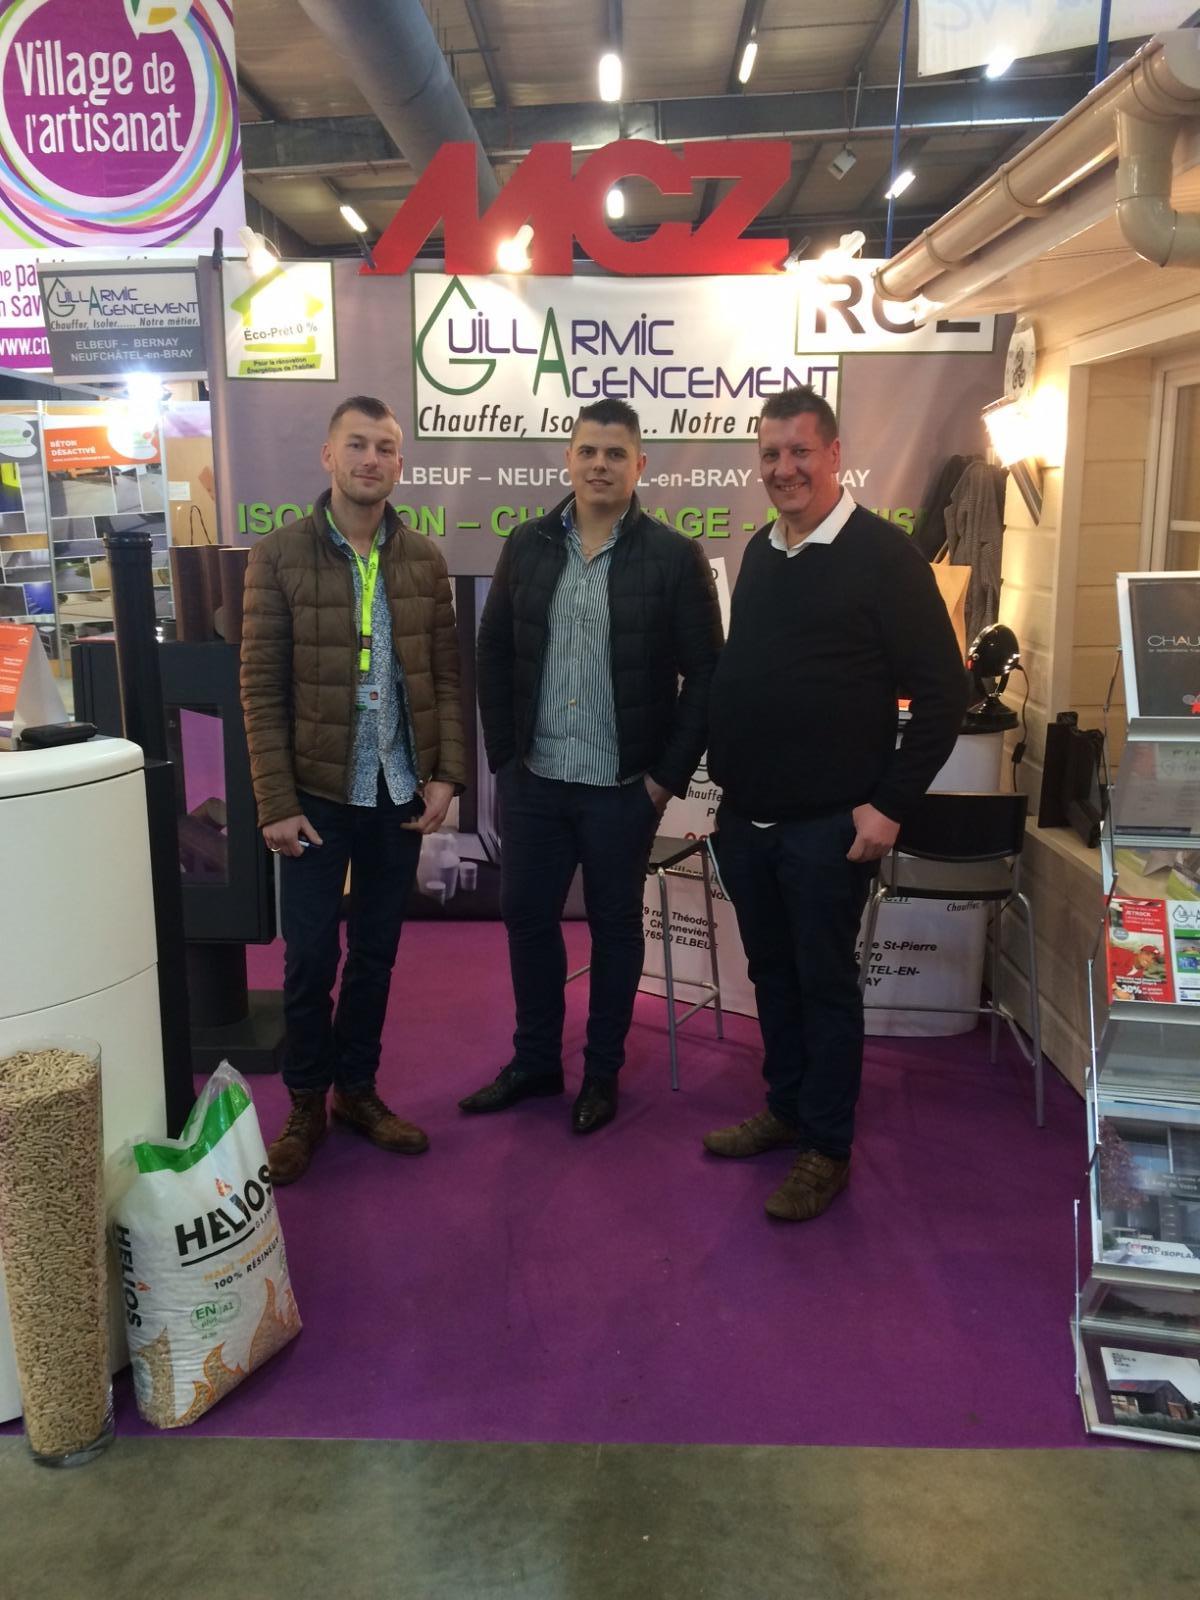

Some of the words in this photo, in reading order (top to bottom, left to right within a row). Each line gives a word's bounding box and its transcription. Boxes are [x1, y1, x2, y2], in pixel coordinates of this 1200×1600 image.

[15, 40, 133, 105] Village
[143, 53, 175, 94] de
[25, 104, 184, 154] l'artisanat
[358, 139, 792, 275] MCZ
[139, 317, 165, 327] Notre
[75, 340, 119, 350] ELBEUF
[133, 337, 179, 348] BERNAY
[419, 404, 527, 438] Chauffer,
[670, 408, 736, 434] Notre
[394, 467, 473, 485] LBEUF
[882, 940, 938, 952] St-Pierre
[213, 1271, 243, 1291] 100%
[195, 1303, 217, 1321] EN
